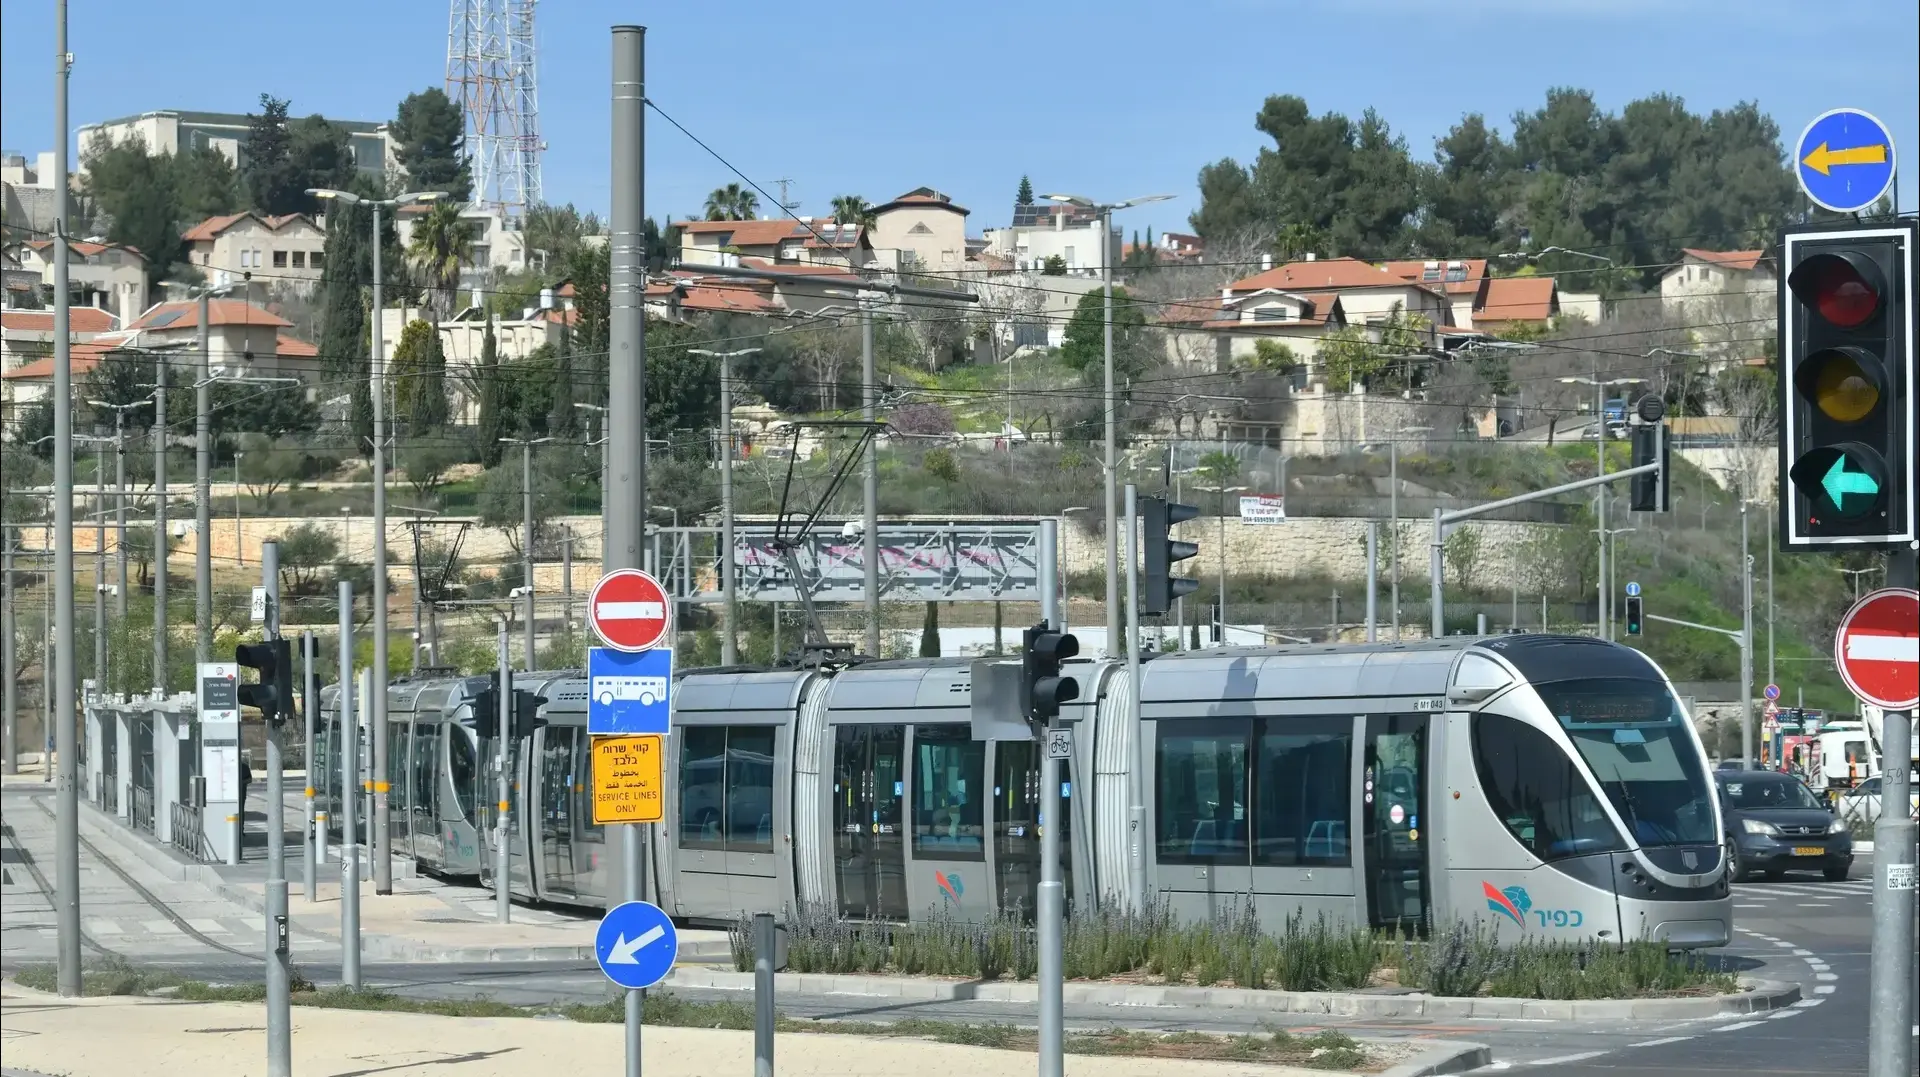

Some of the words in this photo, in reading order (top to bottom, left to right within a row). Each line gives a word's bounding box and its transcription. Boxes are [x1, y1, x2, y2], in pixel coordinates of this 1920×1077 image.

[602, 745, 627, 754] שרות
[633, 744, 649, 754] קווי
[613, 754, 638, 765] בלבד
[1885, 767, 1904, 785] 59
[598, 792, 630, 802] SERVICE
[634, 791, 657, 800] LINES
[616, 804, 636, 813] ONLY
[1534, 910, 1583, 927] כפיר
